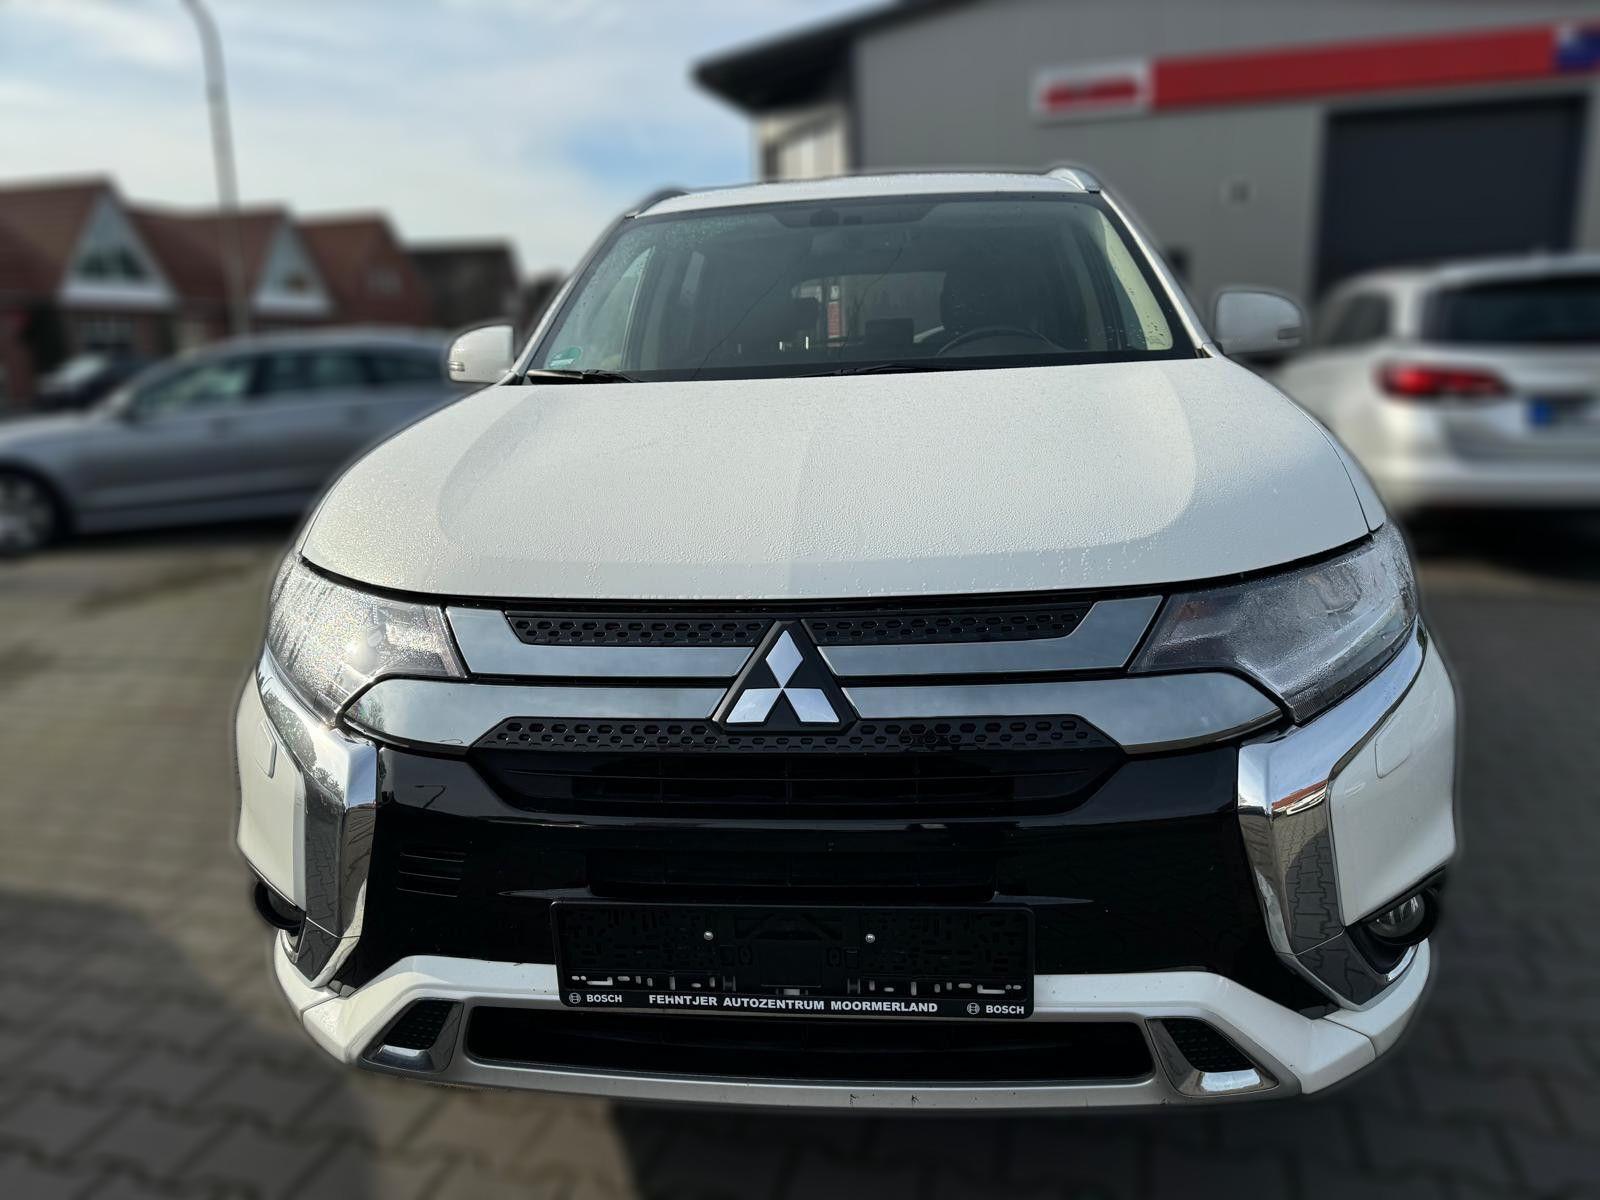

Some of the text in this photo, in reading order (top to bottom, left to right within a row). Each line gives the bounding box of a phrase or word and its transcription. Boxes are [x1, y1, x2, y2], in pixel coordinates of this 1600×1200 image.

[586, 994, 623, 1003] BOSCH
[649, 994, 938, 1013] FEHNTJER AUTOZENTRUM MOORMERLAND
[985, 1005, 1025, 1014] BOSCH
